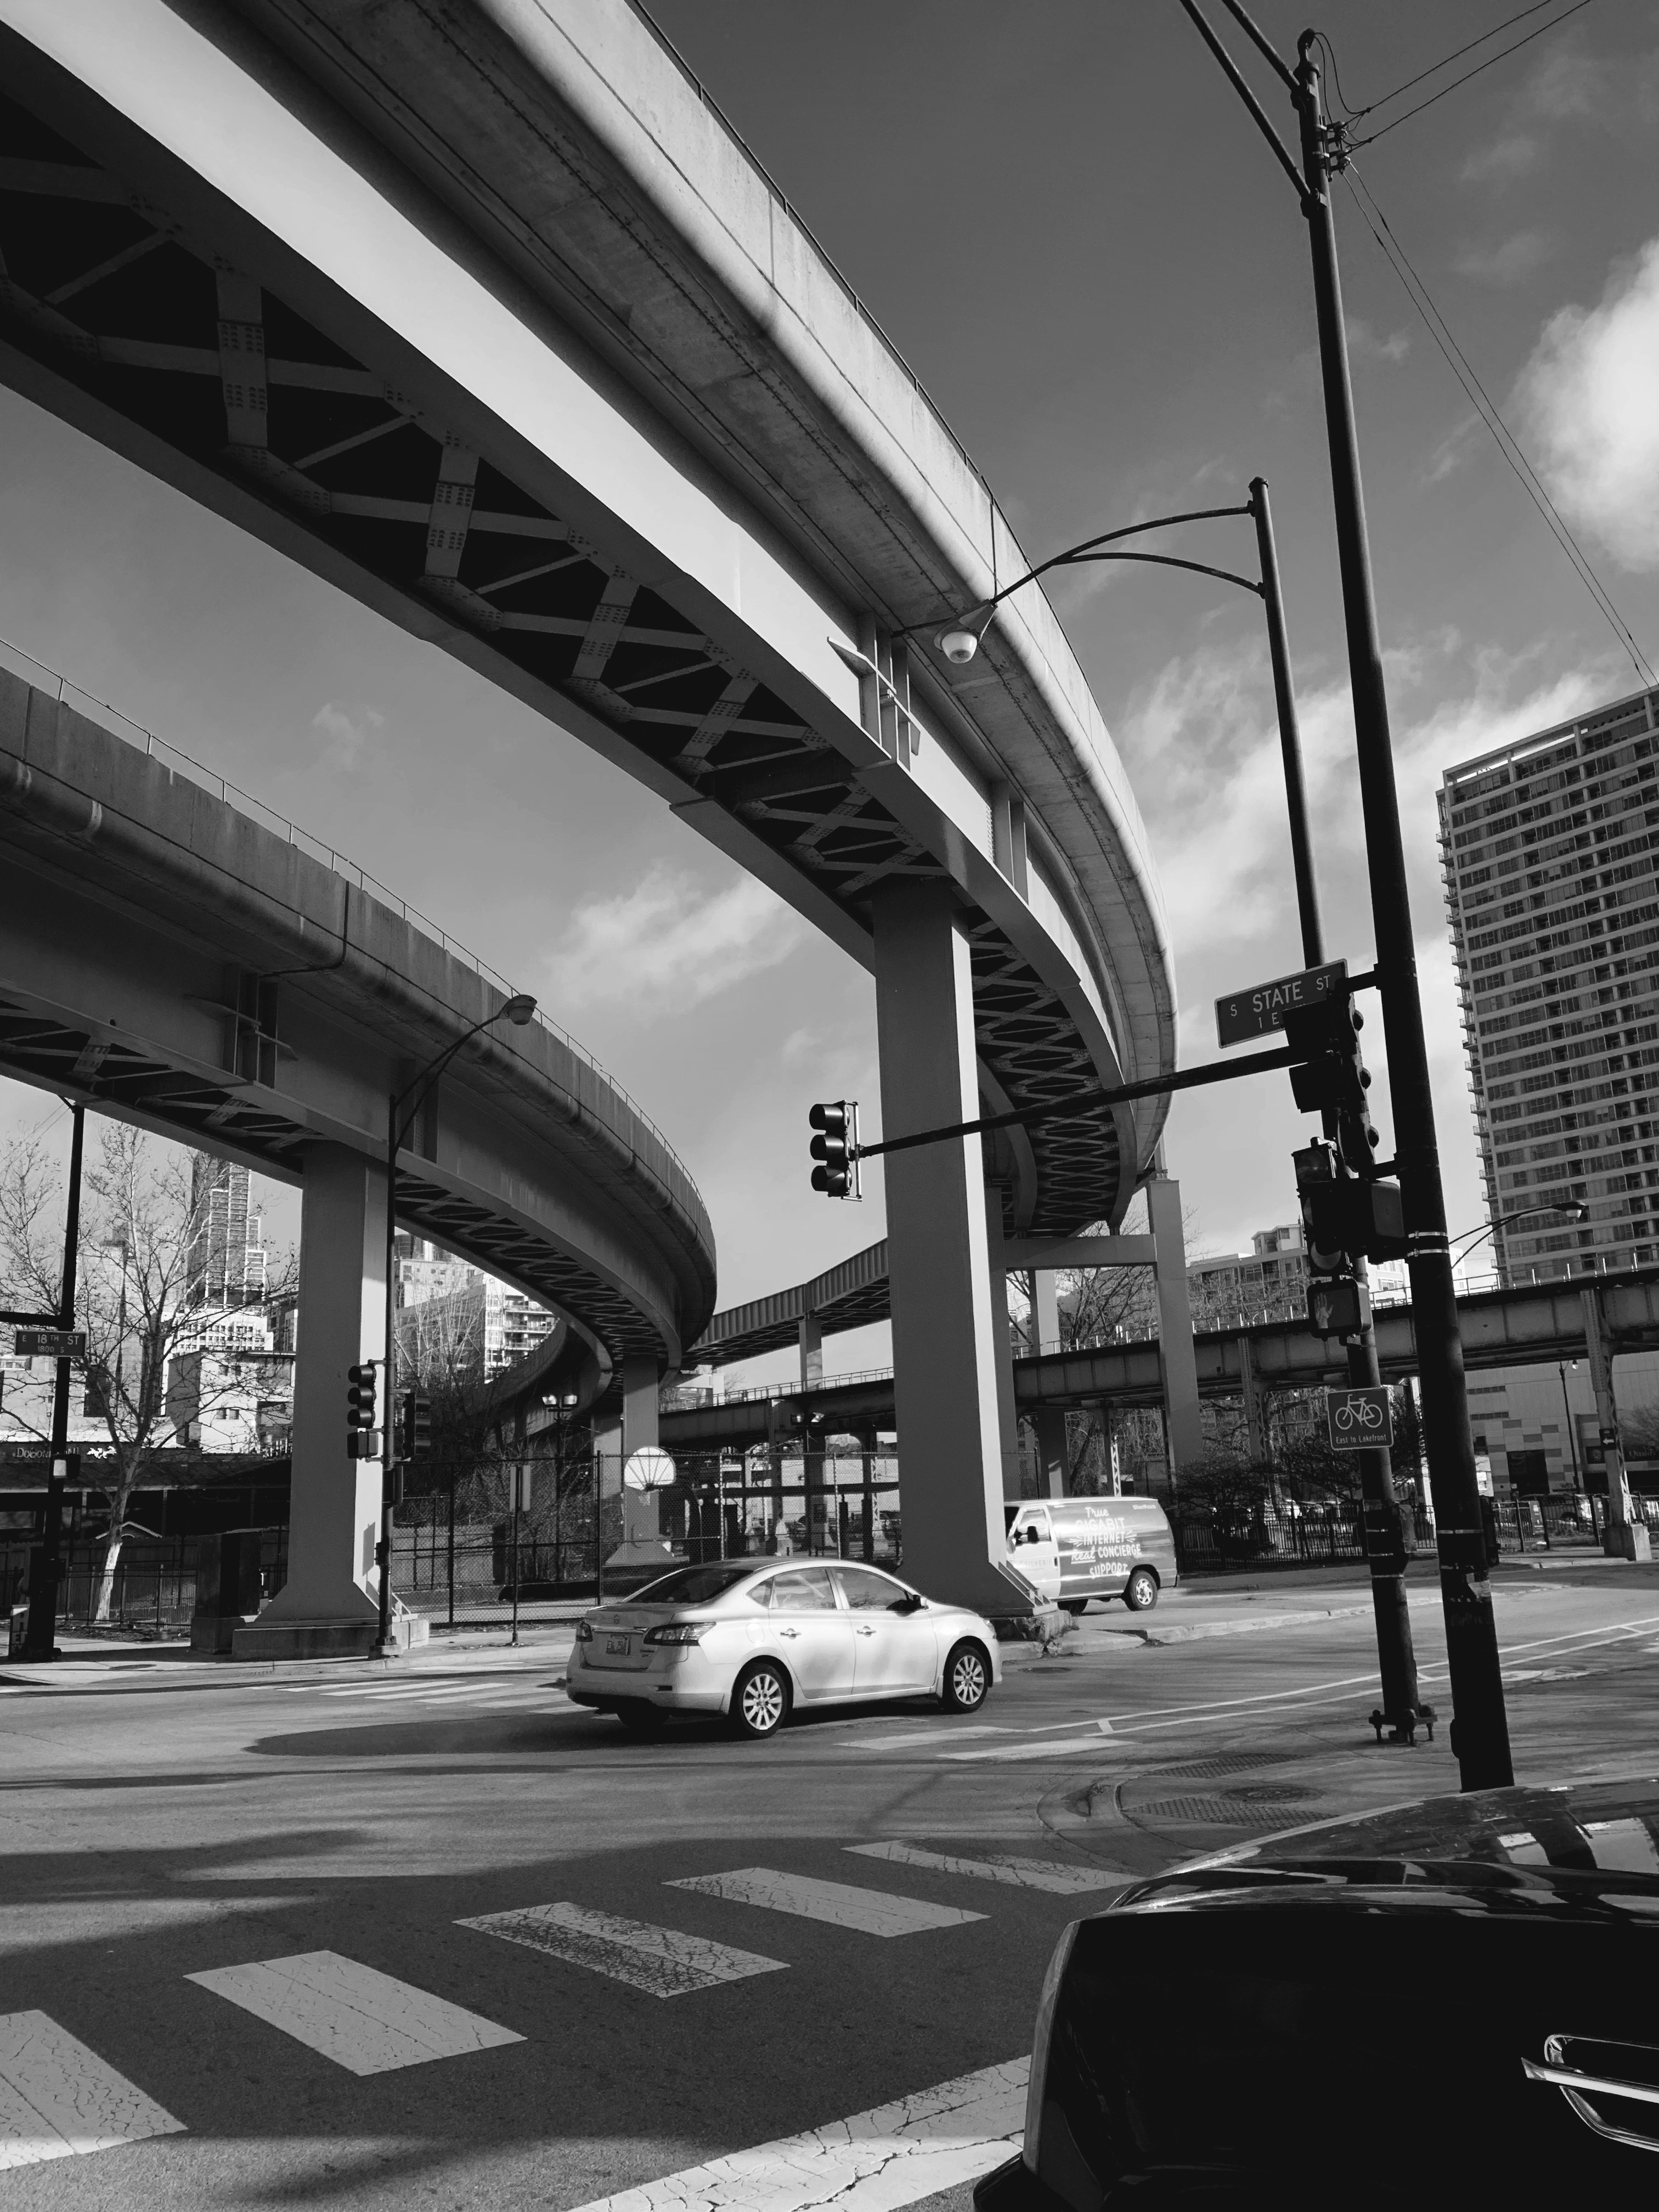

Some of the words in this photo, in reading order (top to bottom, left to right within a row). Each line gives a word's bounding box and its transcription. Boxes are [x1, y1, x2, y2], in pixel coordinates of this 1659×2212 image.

[1231, 1003, 1237, 1017] S
[1252, 980, 1304, 1013] STATE
[1316, 974, 1330, 991] ST
[1258, 1017, 1263, 1029] 1
[1272, 1012, 1280, 1025] E
[37, 1334, 59, 1344] 18TH
[67, 1335, 80, 1345] ST
[1358, 1434, 1387, 1443] Lakefront
[1085, 1506, 1109, 1518] True
[1075, 1517, 1125, 1531] GIGABIT
[1084, 1531, 1125, 1545] INTERNET
[1071, 1546, 1096, 1561] Real
[1098, 1544, 1142, 1558] CONCIERGE
[1090, 1562, 1128, 1577] SUPPORT
